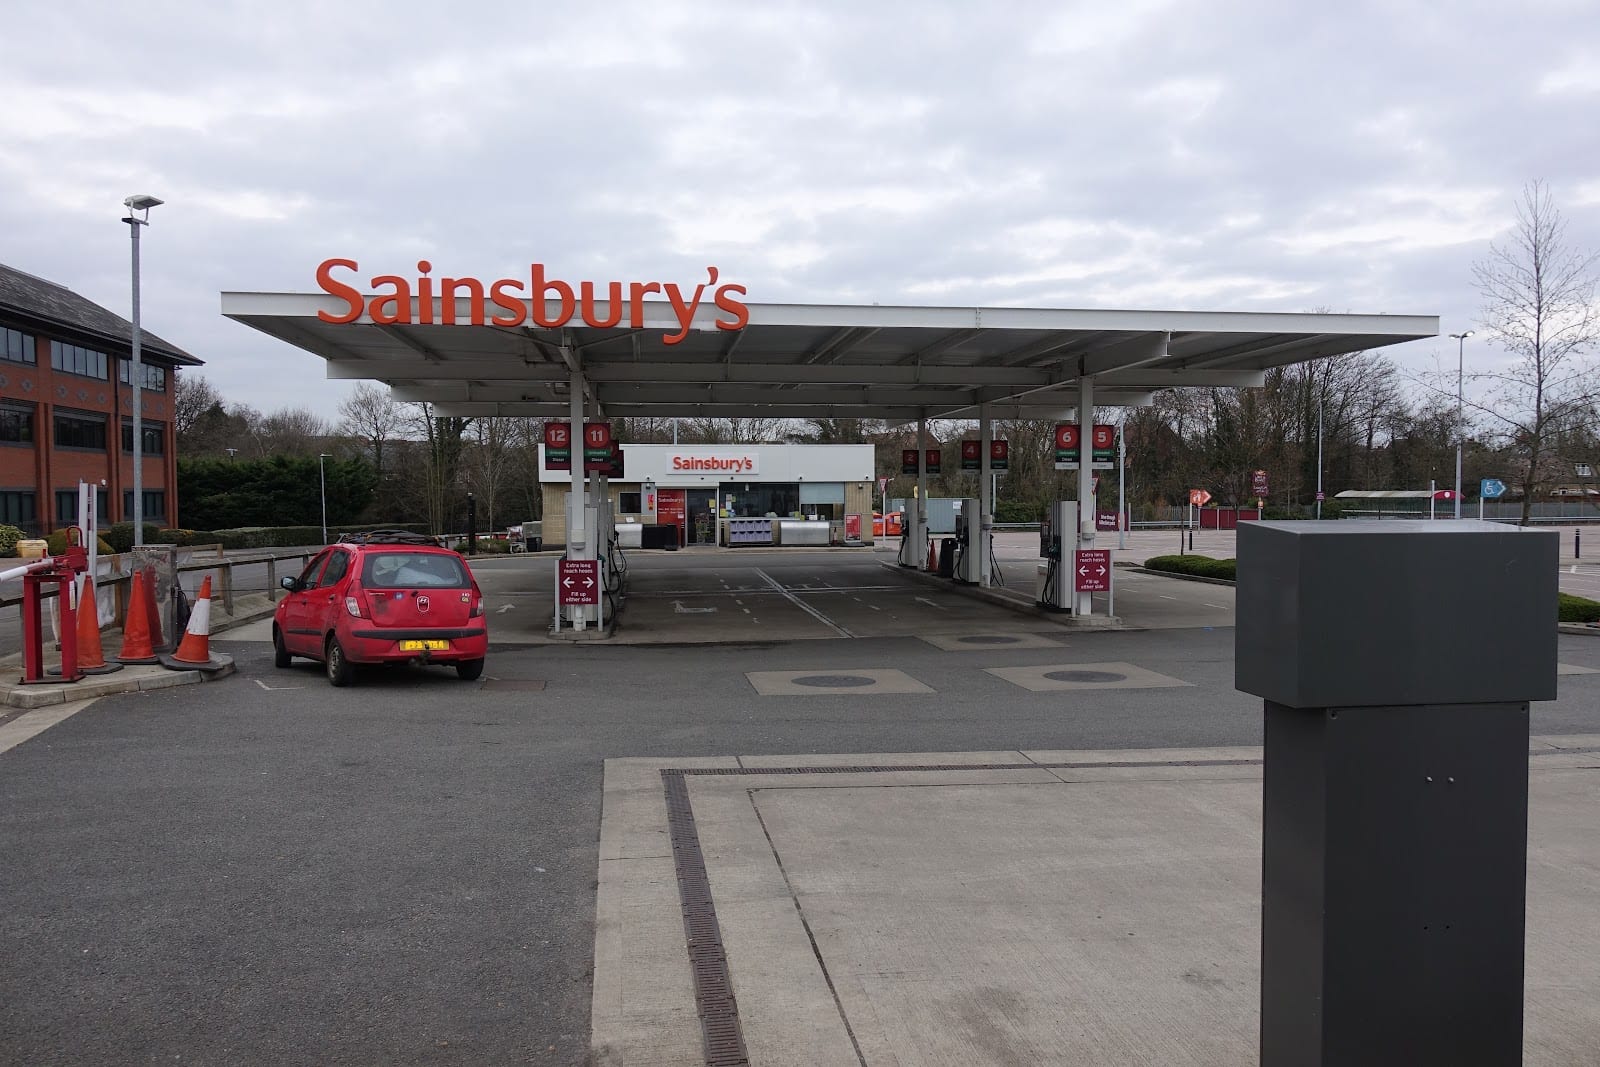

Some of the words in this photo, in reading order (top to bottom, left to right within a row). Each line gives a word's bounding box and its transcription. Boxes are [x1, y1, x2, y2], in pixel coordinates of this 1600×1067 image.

[315, 257, 749, 345] Sainsbury's
[550, 430, 566, 442] 12
[590, 430, 603, 442] 11
[1062, 432, 1072, 442] 6
[1098, 432, 1106, 442] 5
[967, 446, 974, 454] 4
[996, 446, 1002, 454] 3
[673, 456, 752, 472] Sainsbury's
